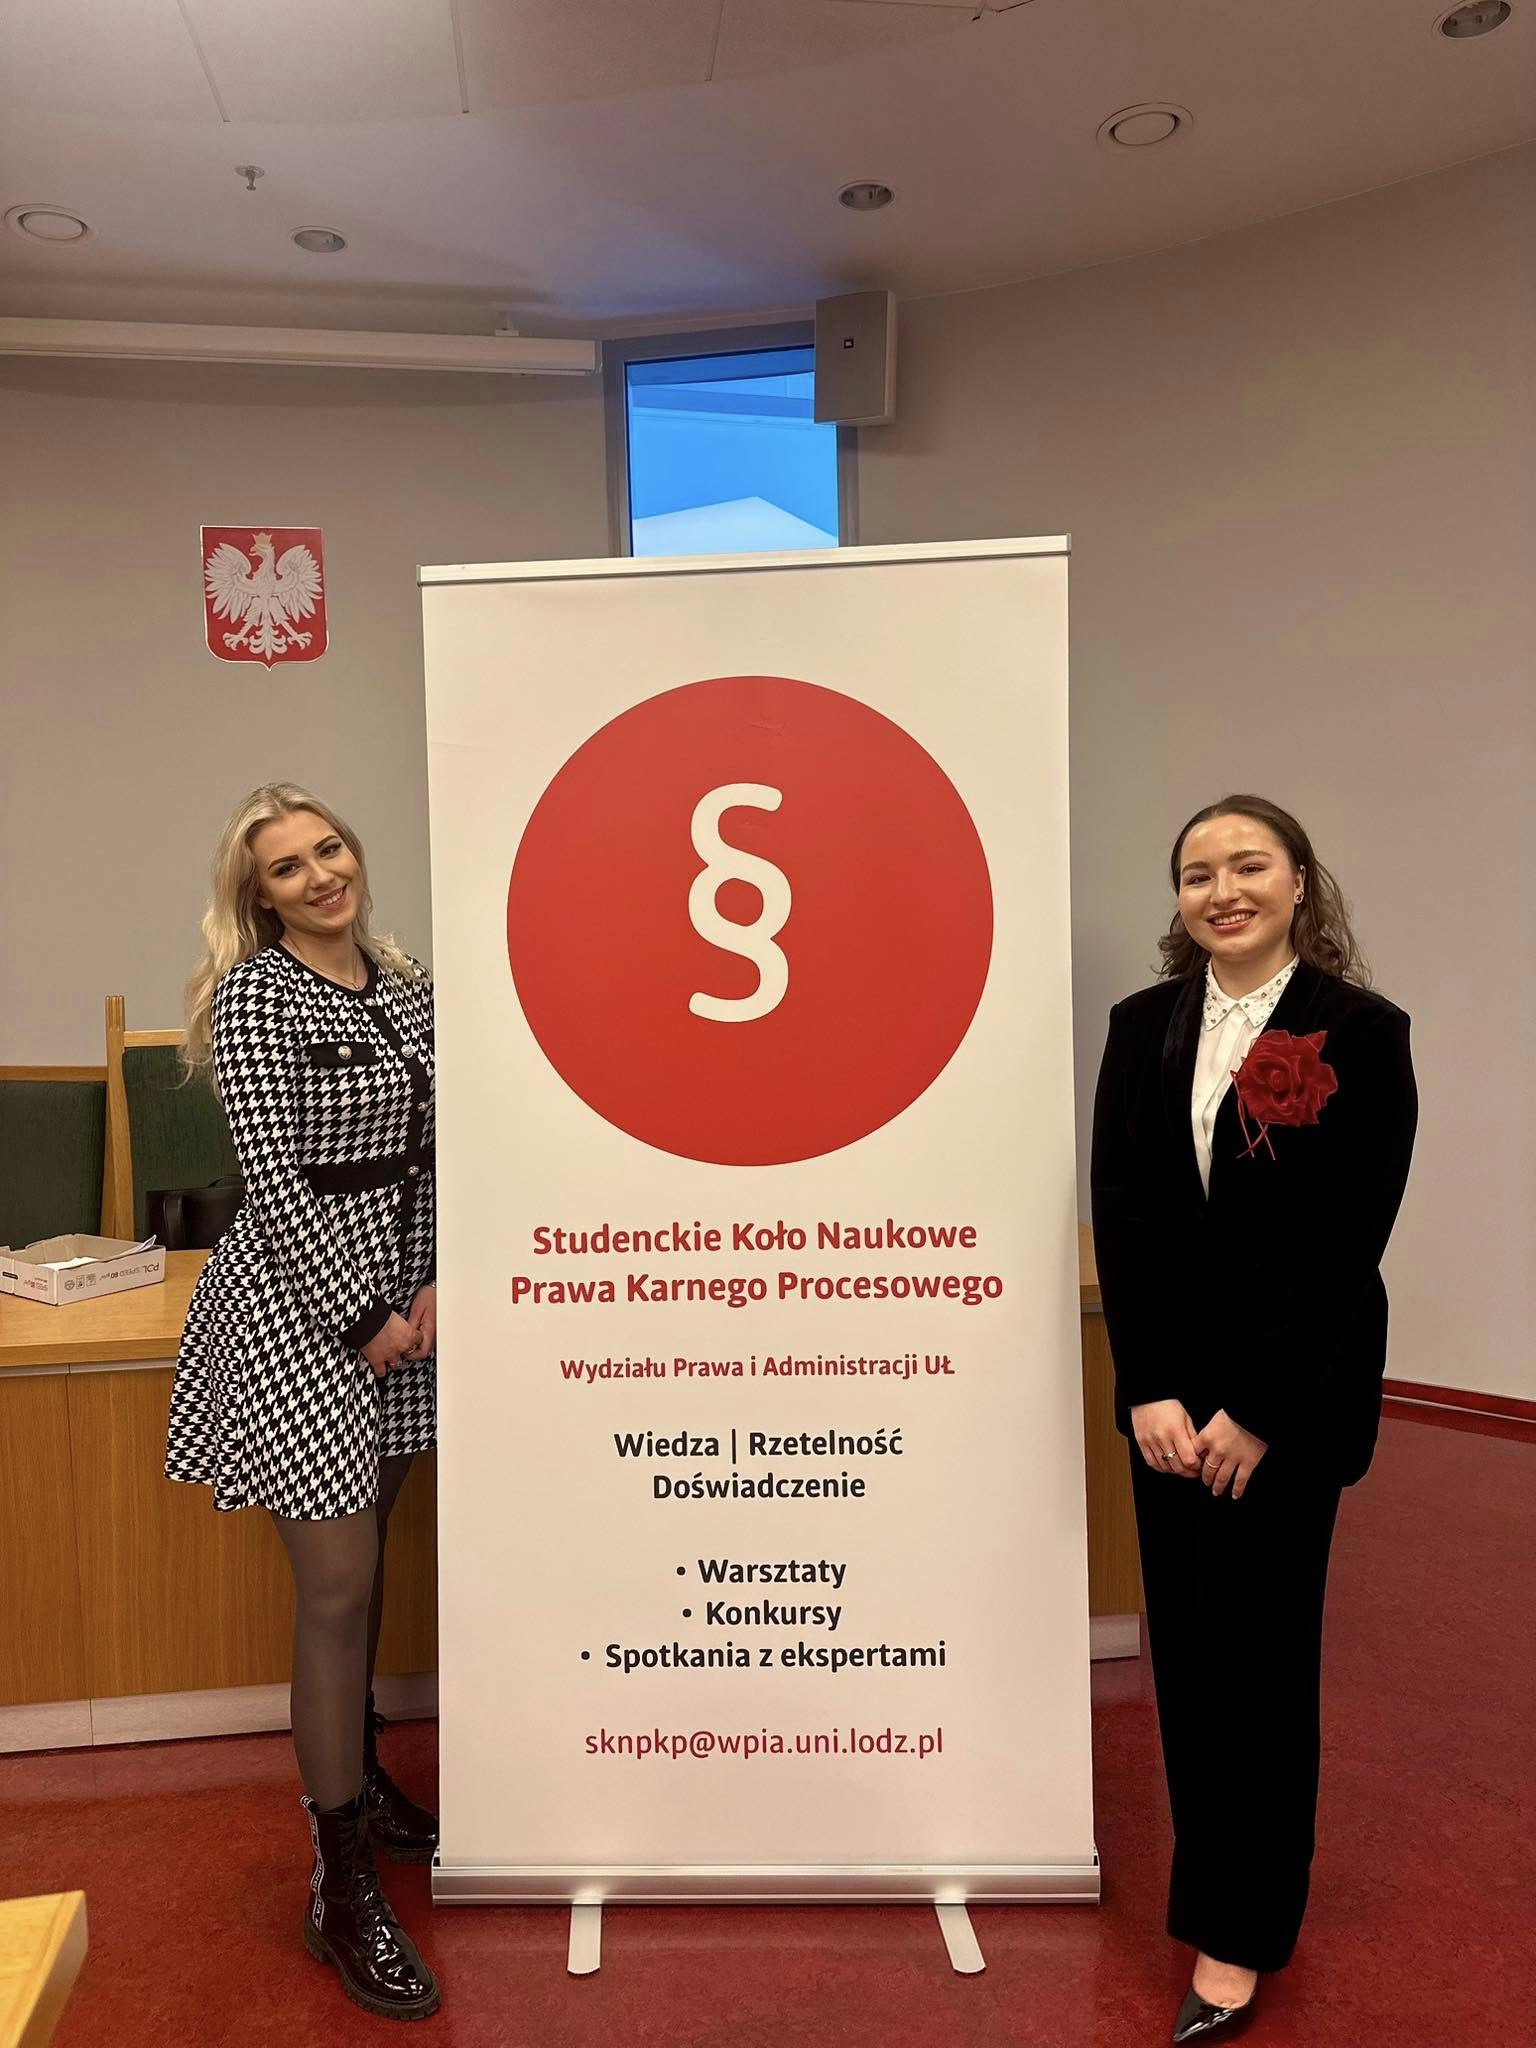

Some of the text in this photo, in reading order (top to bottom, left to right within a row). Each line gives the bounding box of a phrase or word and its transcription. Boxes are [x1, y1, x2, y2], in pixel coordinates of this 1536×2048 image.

[533, 1217, 977, 1255] Studenckie Koło Naukowe
[511, 1271, 1003, 1309] Prawa Karnego Procesowego
[560, 1353, 956, 1385] Wydziału Prawa i Administracji UŁ
[613, 1430, 720, 1458] Wiedza
[749, 1427, 904, 1457] Rzetelność
[653, 1471, 866, 1499] Doświadczenie
[697, 1558, 847, 1590] Warsztaty
[706, 1599, 842, 1632] Konkursy
[605, 1639, 946, 1674] Spotkania z ekspertami
[585, 1727, 943, 1760] sknpkp@wpia.uni.lodz.pl
